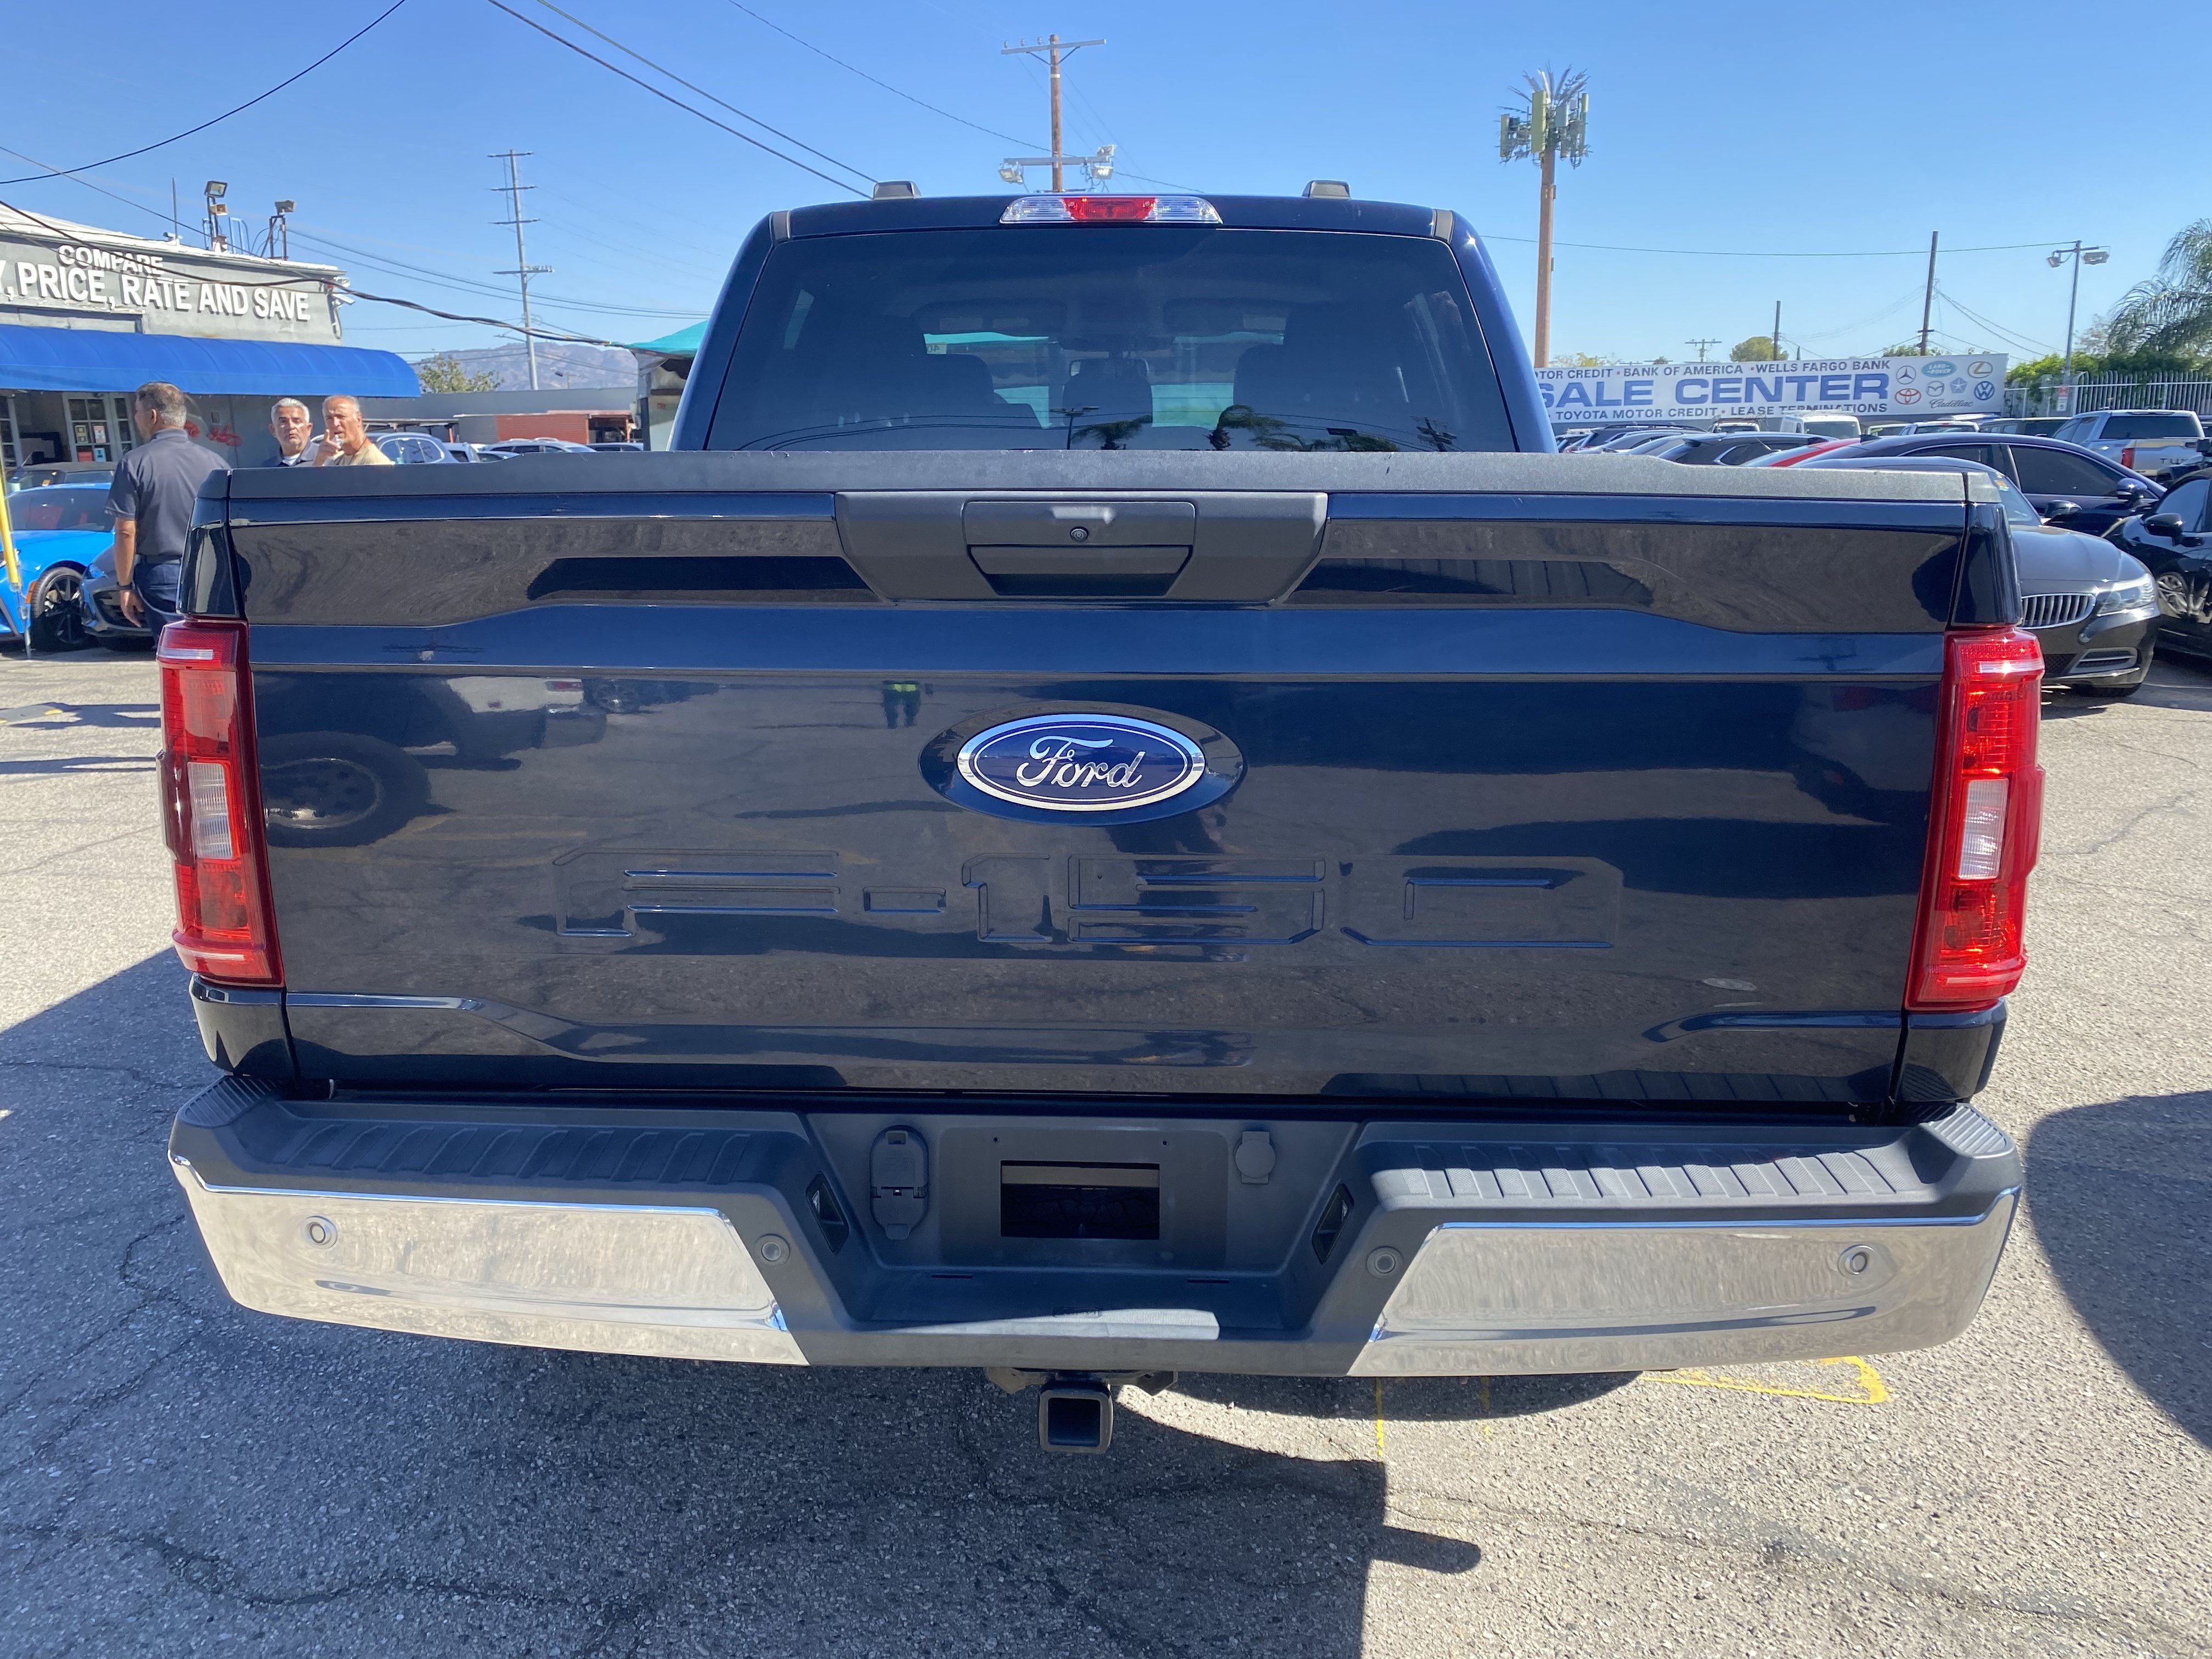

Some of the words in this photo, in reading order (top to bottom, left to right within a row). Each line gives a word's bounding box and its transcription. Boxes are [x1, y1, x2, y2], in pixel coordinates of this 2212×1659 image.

[57, 245, 165, 275] COMPARE
[16, 262, 116, 310] PRICE,
[120, 274, 192, 311] RATE
[198, 283, 249, 315] AND
[253, 288, 311, 320] SAVE
[1567, 369, 1613, 379] CREDIT
[1624, 367, 1658, 377] BANK
[1663, 366, 1680, 375] OF
[1683, 365, 1743, 375] AMERICA
[1756, 363, 1798, 373] WELLS
[1803, 362, 1847, 372] FARGO
[1853, 360, 1891, 370] BANK
[1675, 373, 1889, 404] CENTER
[1929, 398, 1974, 408] Cadillac
[1556, 411, 1608, 420] TOYOTA
[1612, 409, 1663, 419] MOTOR
[1668, 408, 1718, 417] CREDIT
[1731, 406, 1774, 416] LEASE
[1017, 735, 1146, 787] Ford
